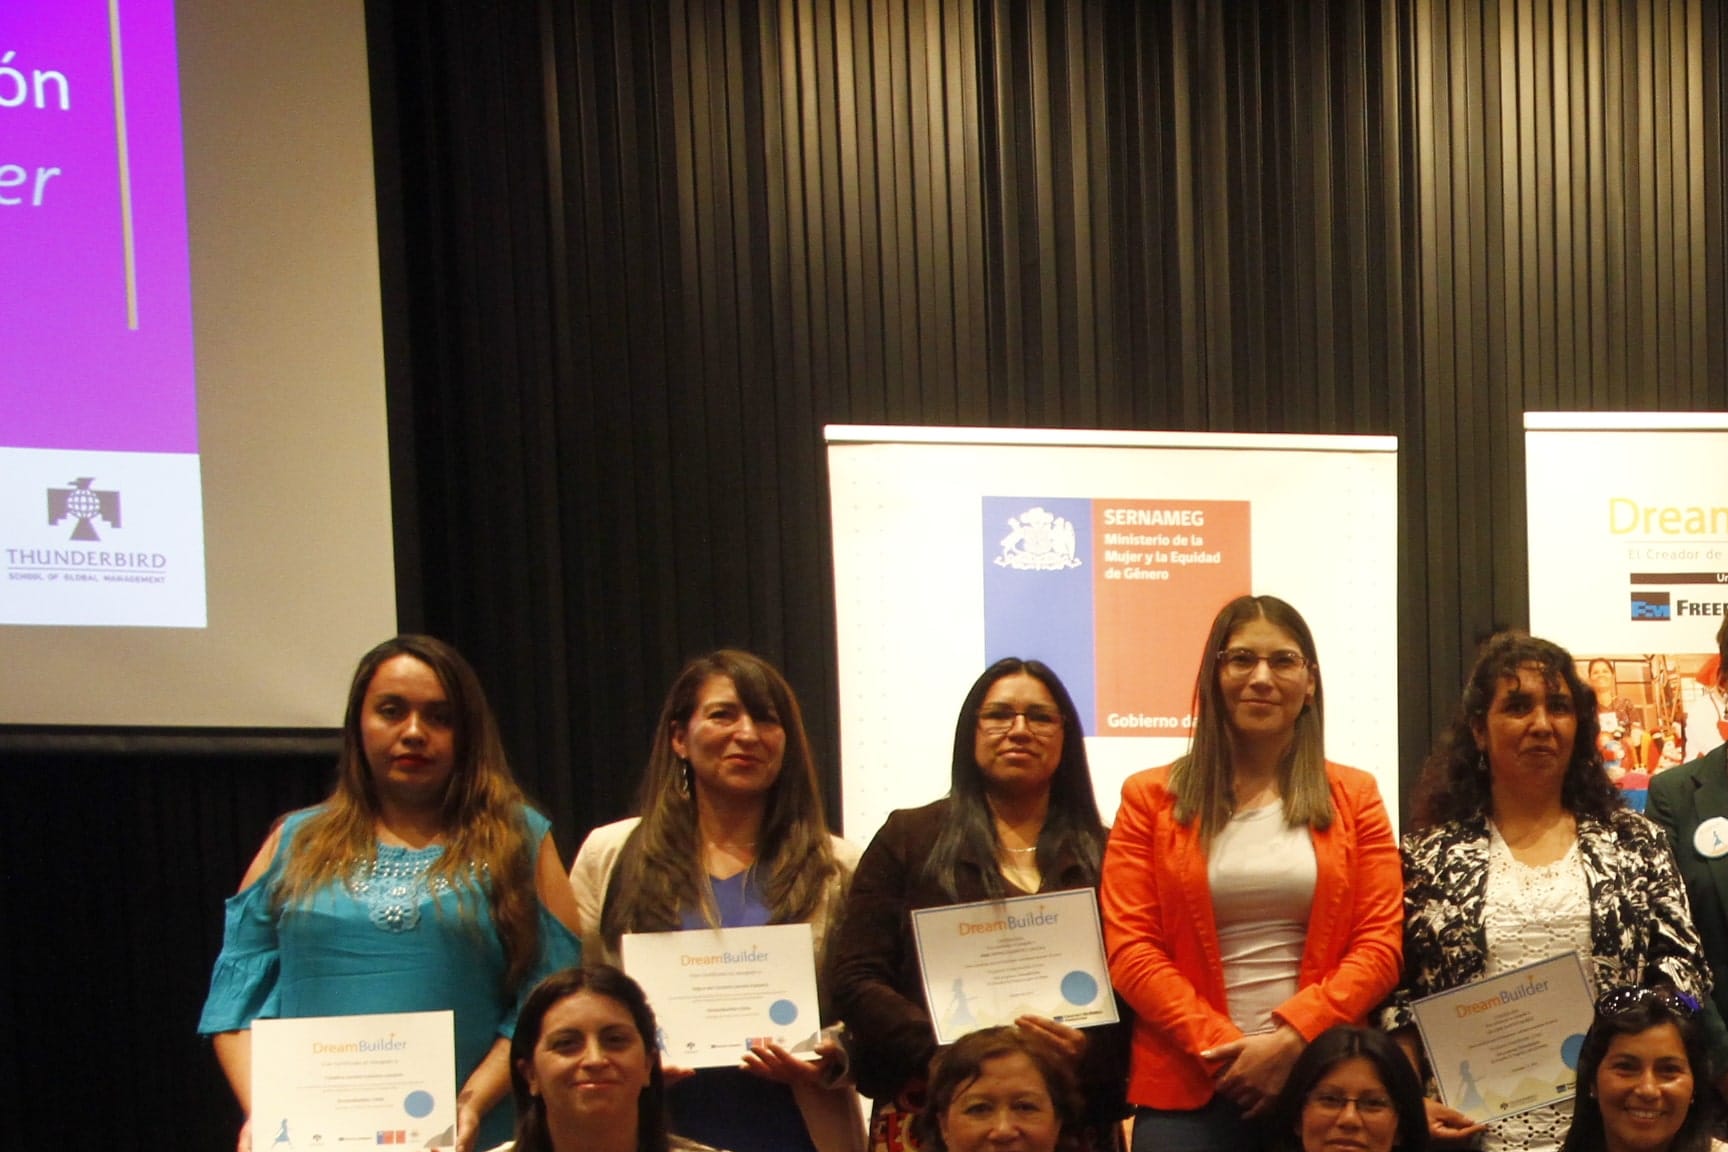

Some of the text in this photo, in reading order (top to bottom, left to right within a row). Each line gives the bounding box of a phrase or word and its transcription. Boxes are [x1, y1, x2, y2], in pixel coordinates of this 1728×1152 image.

[1104, 509, 1204, 526] SERNAMEG
[1104, 533, 1203, 546] Ministerio de la
[6, 549, 167, 569] THUNDERBIRD
[1104, 550, 1221, 566] Mujer y la Equidad
[1628, 550, 1642, 560] El
[1647, 550, 1700, 560] Creador
[1706, 550, 1722, 560] de
[1104, 566, 1169, 580] de Género
[1107, 712, 1178, 728] Gobierno
[958, 911, 1059, 937] DreamBuilder
[680, 950, 769, 967] DreamBuilder
[1455, 979, 1550, 1019] DreamBuilder
[312, 1038, 407, 1055] DreamBuilder
